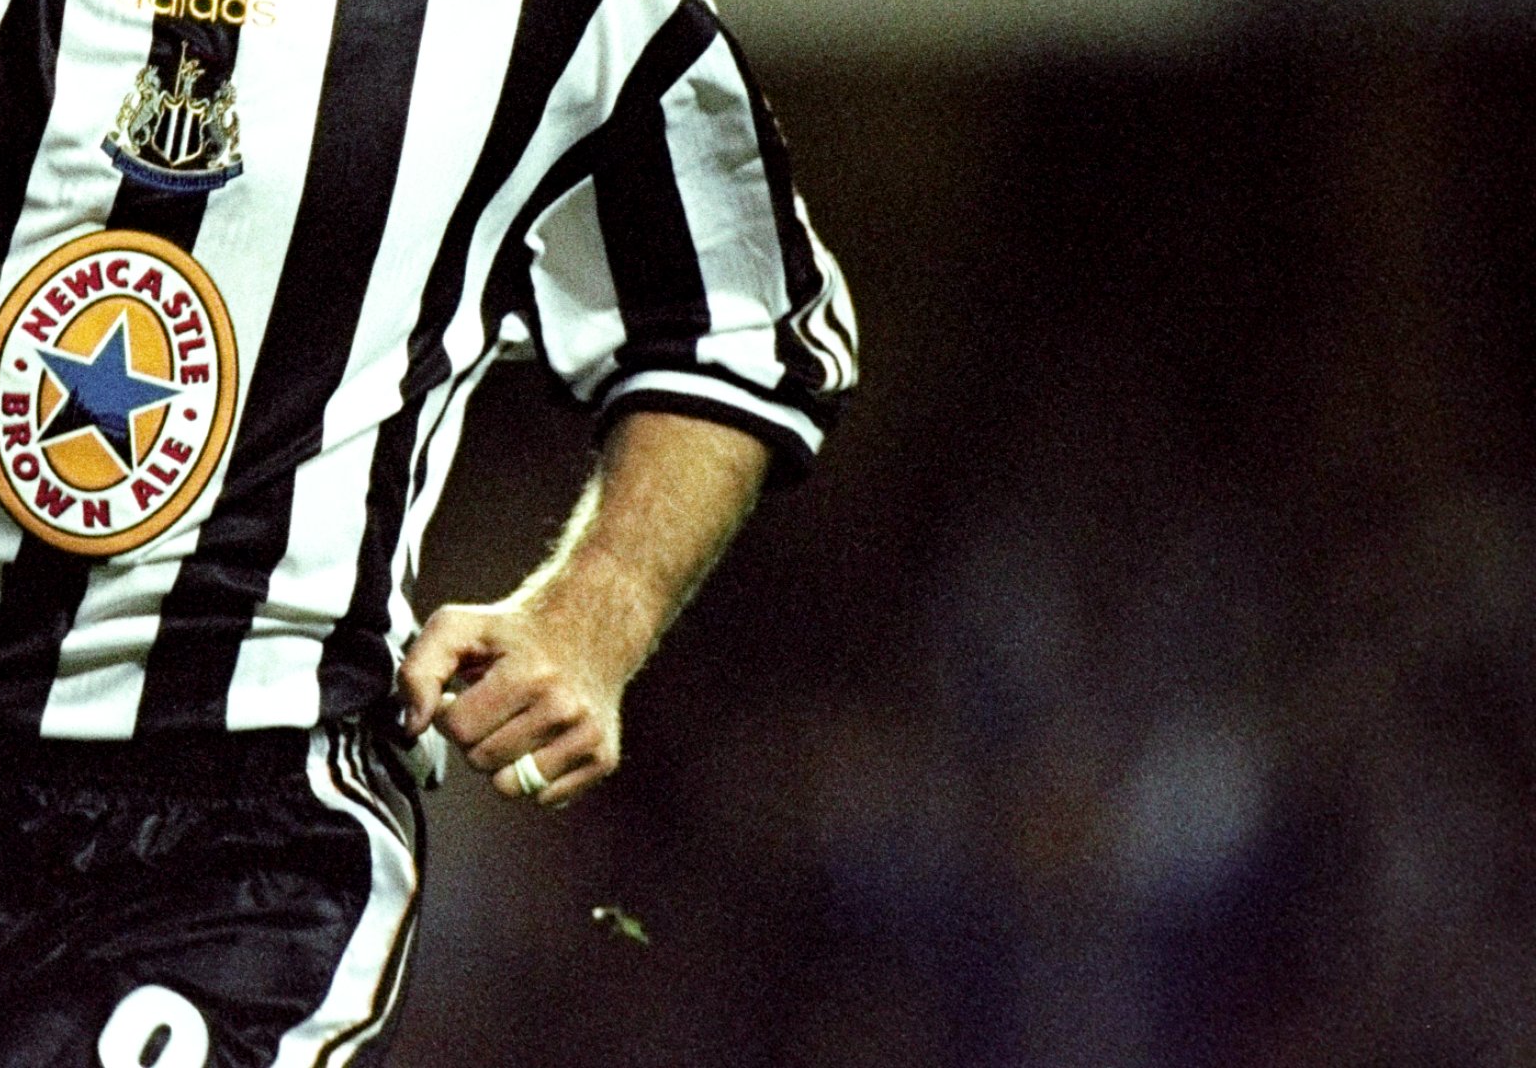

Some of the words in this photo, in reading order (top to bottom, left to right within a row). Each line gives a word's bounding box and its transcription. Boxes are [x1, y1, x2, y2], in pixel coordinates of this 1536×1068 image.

[21, 259, 210, 385] NEWCASTLE
[1, 391, 111, 528] BROWN
[130, 437, 193, 511] ALE
